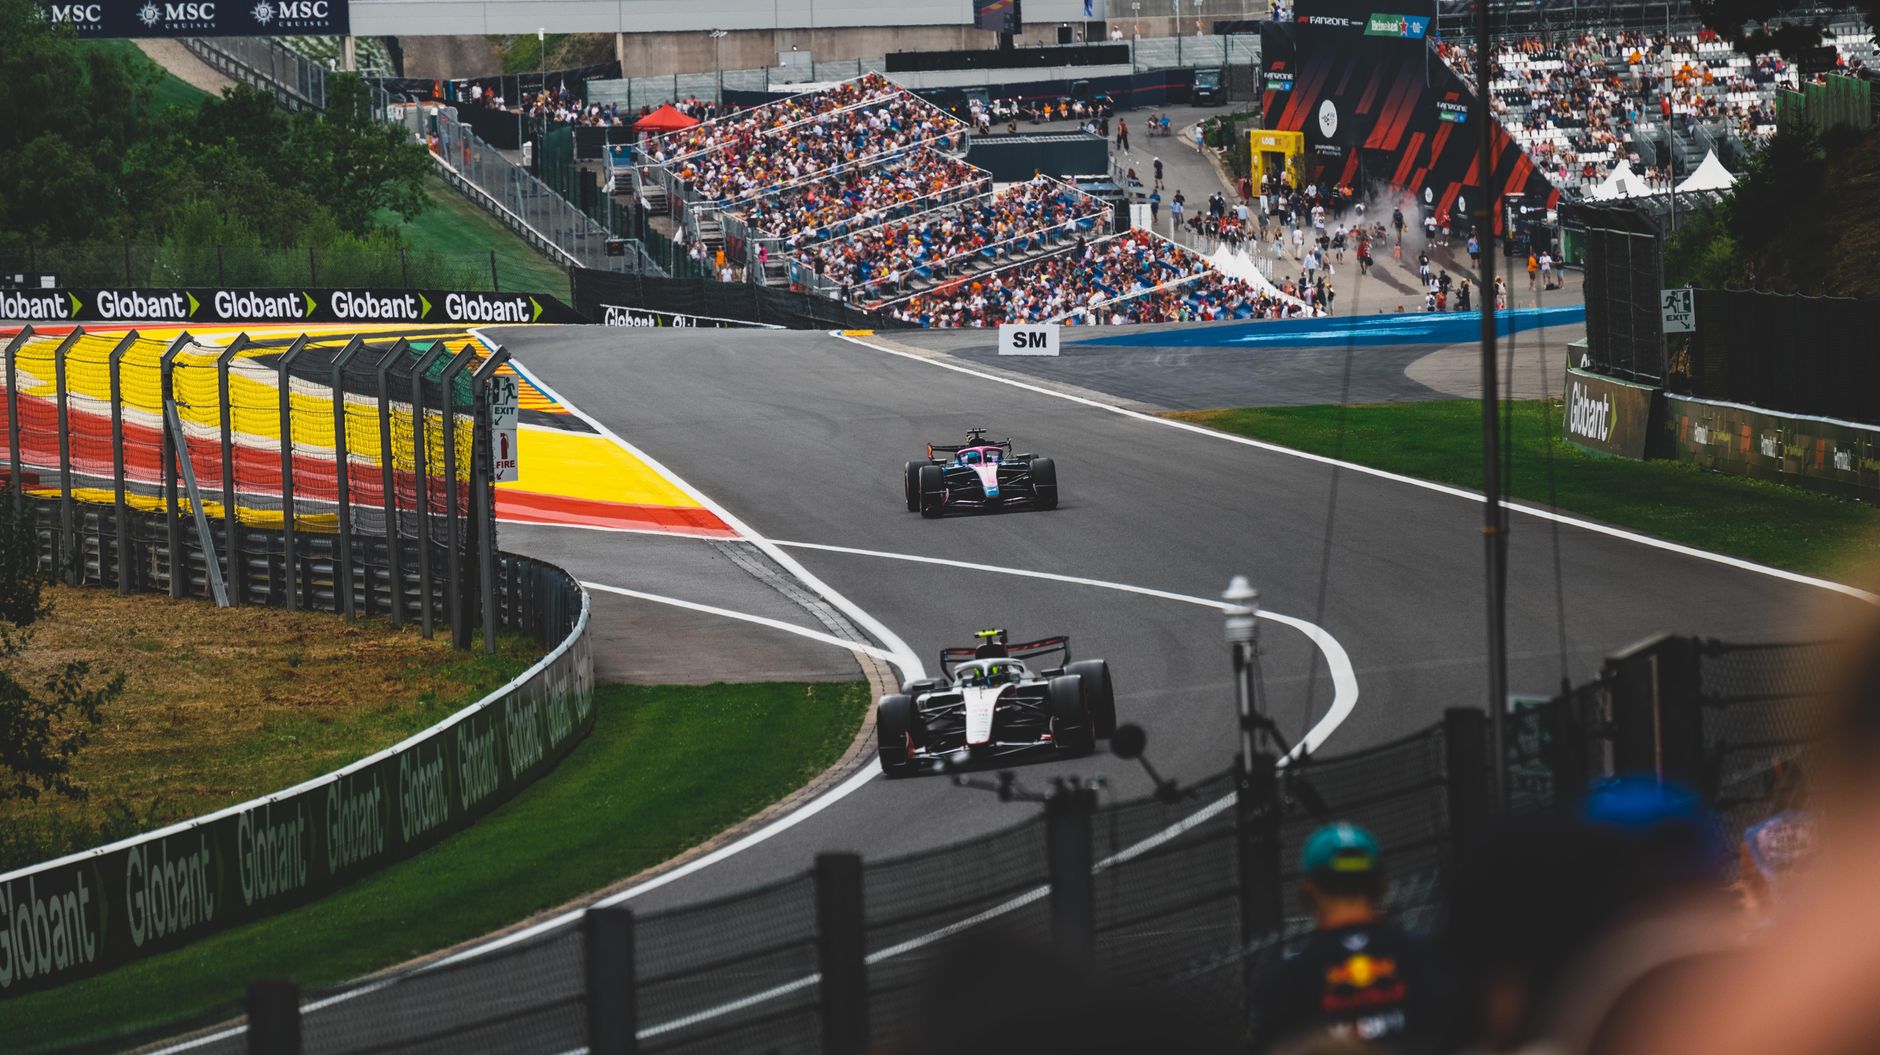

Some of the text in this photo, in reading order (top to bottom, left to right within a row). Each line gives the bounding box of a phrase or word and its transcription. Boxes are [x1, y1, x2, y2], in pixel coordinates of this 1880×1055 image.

[51, 4, 101, 22] MSC
[165, 2, 215, 20] MSC
[278, 1, 328, 19] MSC
[0, 291, 68, 318] lobant
[97, 291, 186, 318] Globant
[214, 291, 303, 319] Globant
[331, 291, 418, 319] Globant
[445, 293, 529, 322] Globant
[1013, 332, 1047, 348] SM
[494, 406, 515, 415] EXIT
[1571, 381, 1609, 442] Globant
[496, 460, 515, 469] FIRE
[457, 714, 499, 811] Globant
[400, 743, 448, 843] Globant
[326, 772, 383, 875] Globant
[238, 802, 306, 906] Globant
[126, 833, 213, 947] Globant
